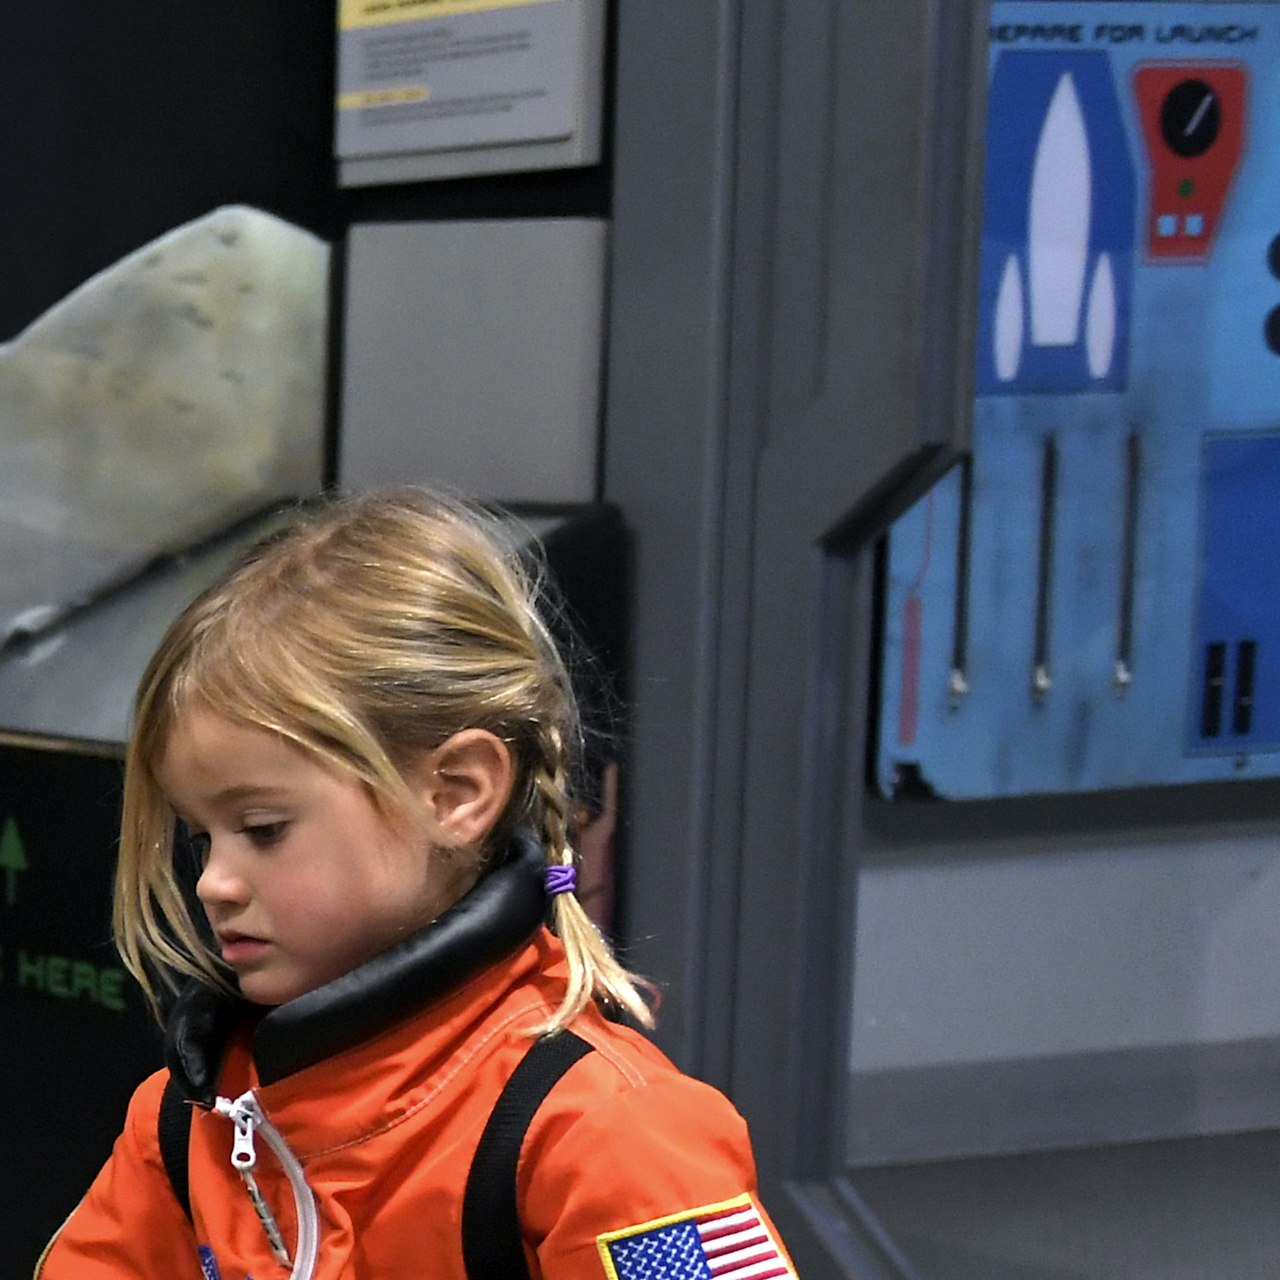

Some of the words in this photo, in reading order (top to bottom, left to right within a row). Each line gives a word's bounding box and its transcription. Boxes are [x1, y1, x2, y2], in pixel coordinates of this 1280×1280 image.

[1095, 24, 1144, 43] FOR
[1155, 23, 1259, 43] LAUNCH
[17, 950, 126, 1011] HERE
